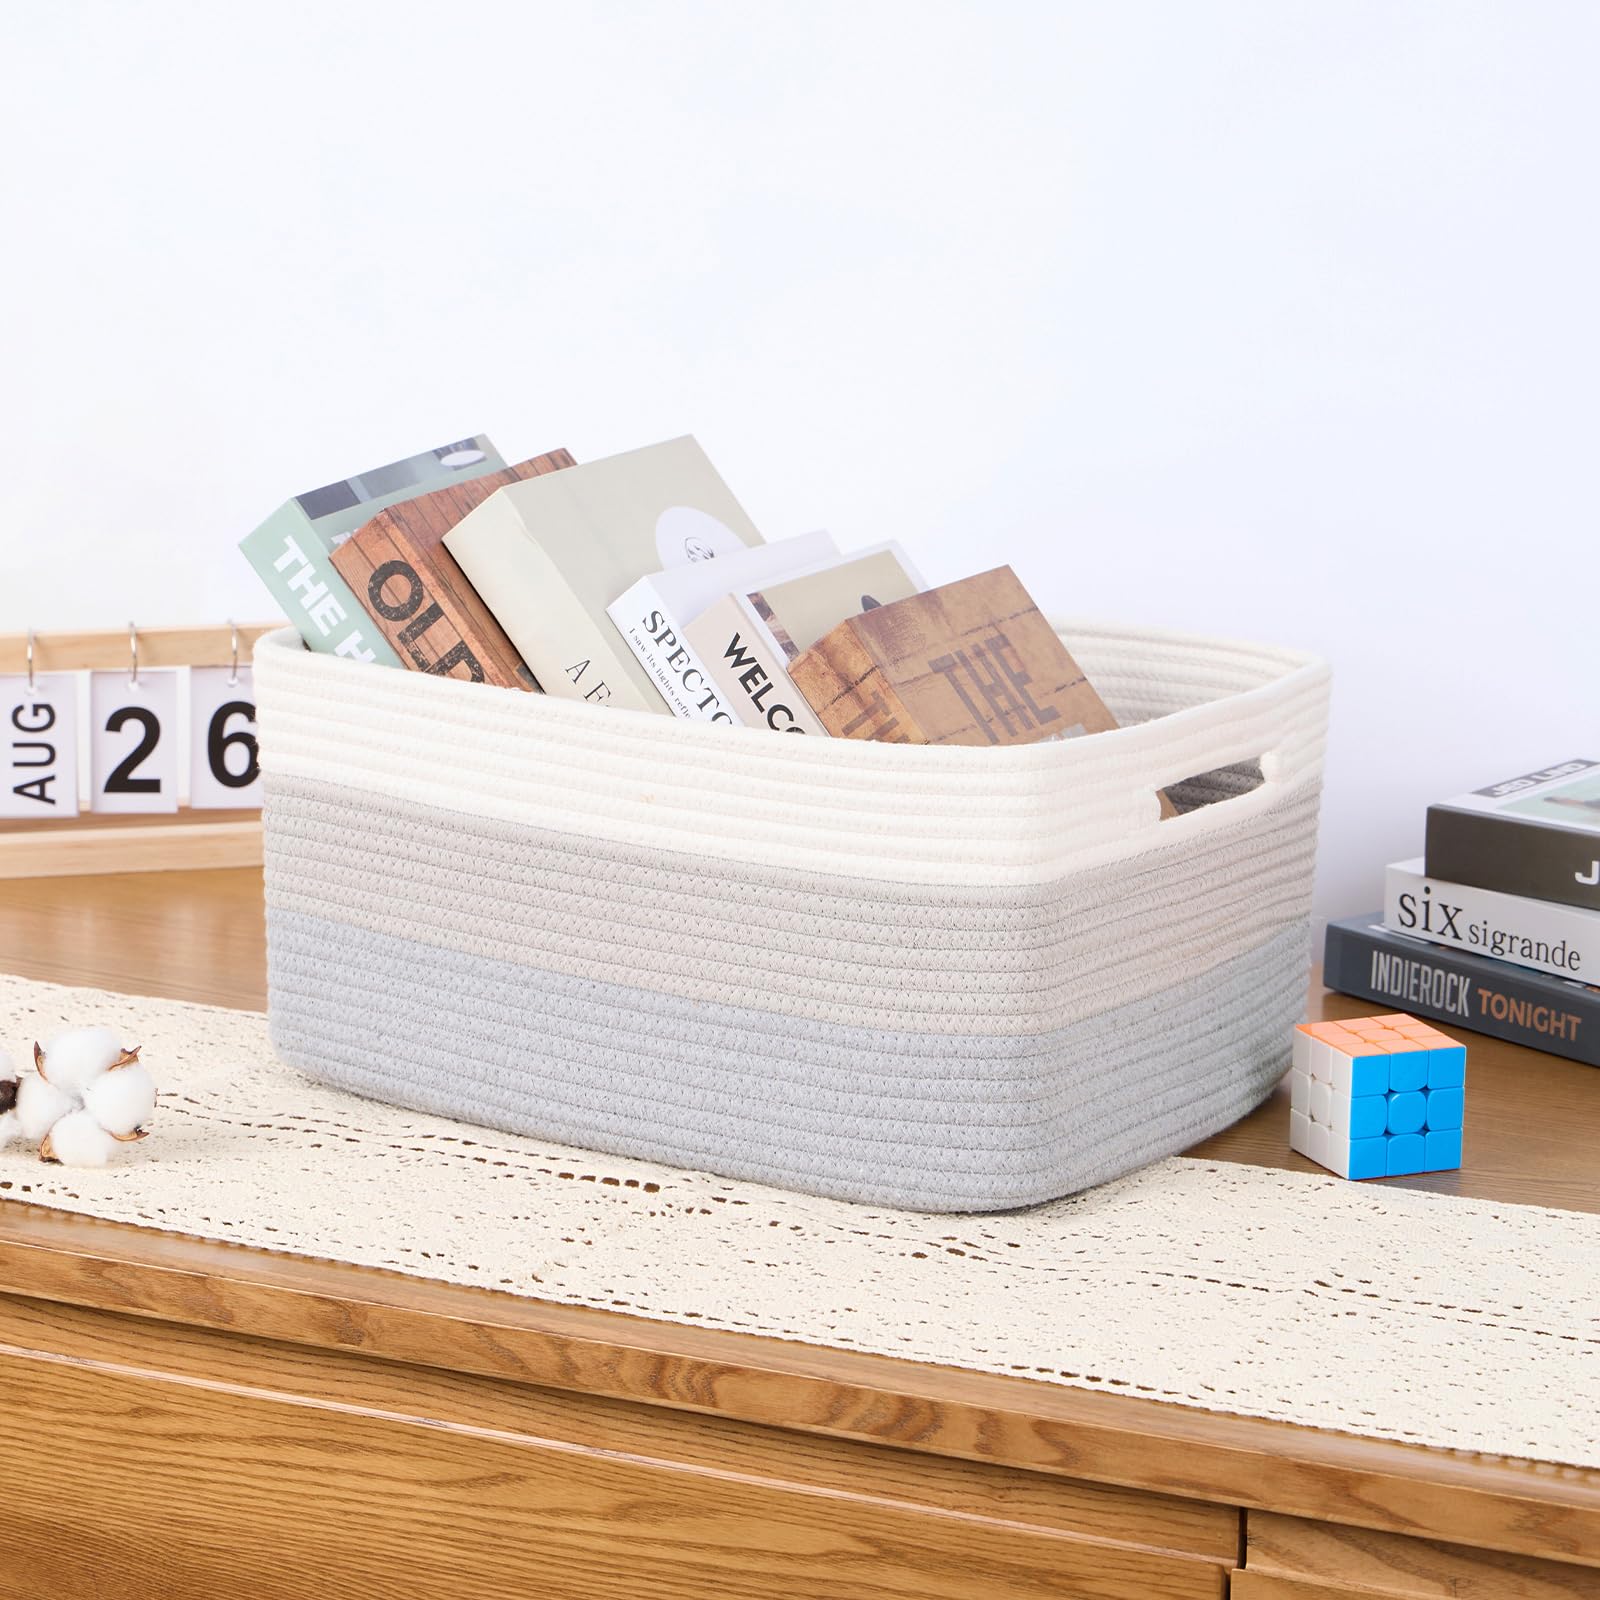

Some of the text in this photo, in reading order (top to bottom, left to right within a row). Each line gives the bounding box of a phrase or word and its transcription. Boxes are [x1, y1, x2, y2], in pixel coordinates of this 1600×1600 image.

[273, 535, 348, 637] THE
[724, 632, 806, 734] WELC
[928, 633, 1062, 745] THE
[12, 703, 56, 805] AUG
[103, 706, 161, 793] 2
[207, 701, 261, 788] 6
[1469, 920, 1581, 971] sigrande
[1370, 950, 1582, 1041] INDIEROCK TONIGHT
